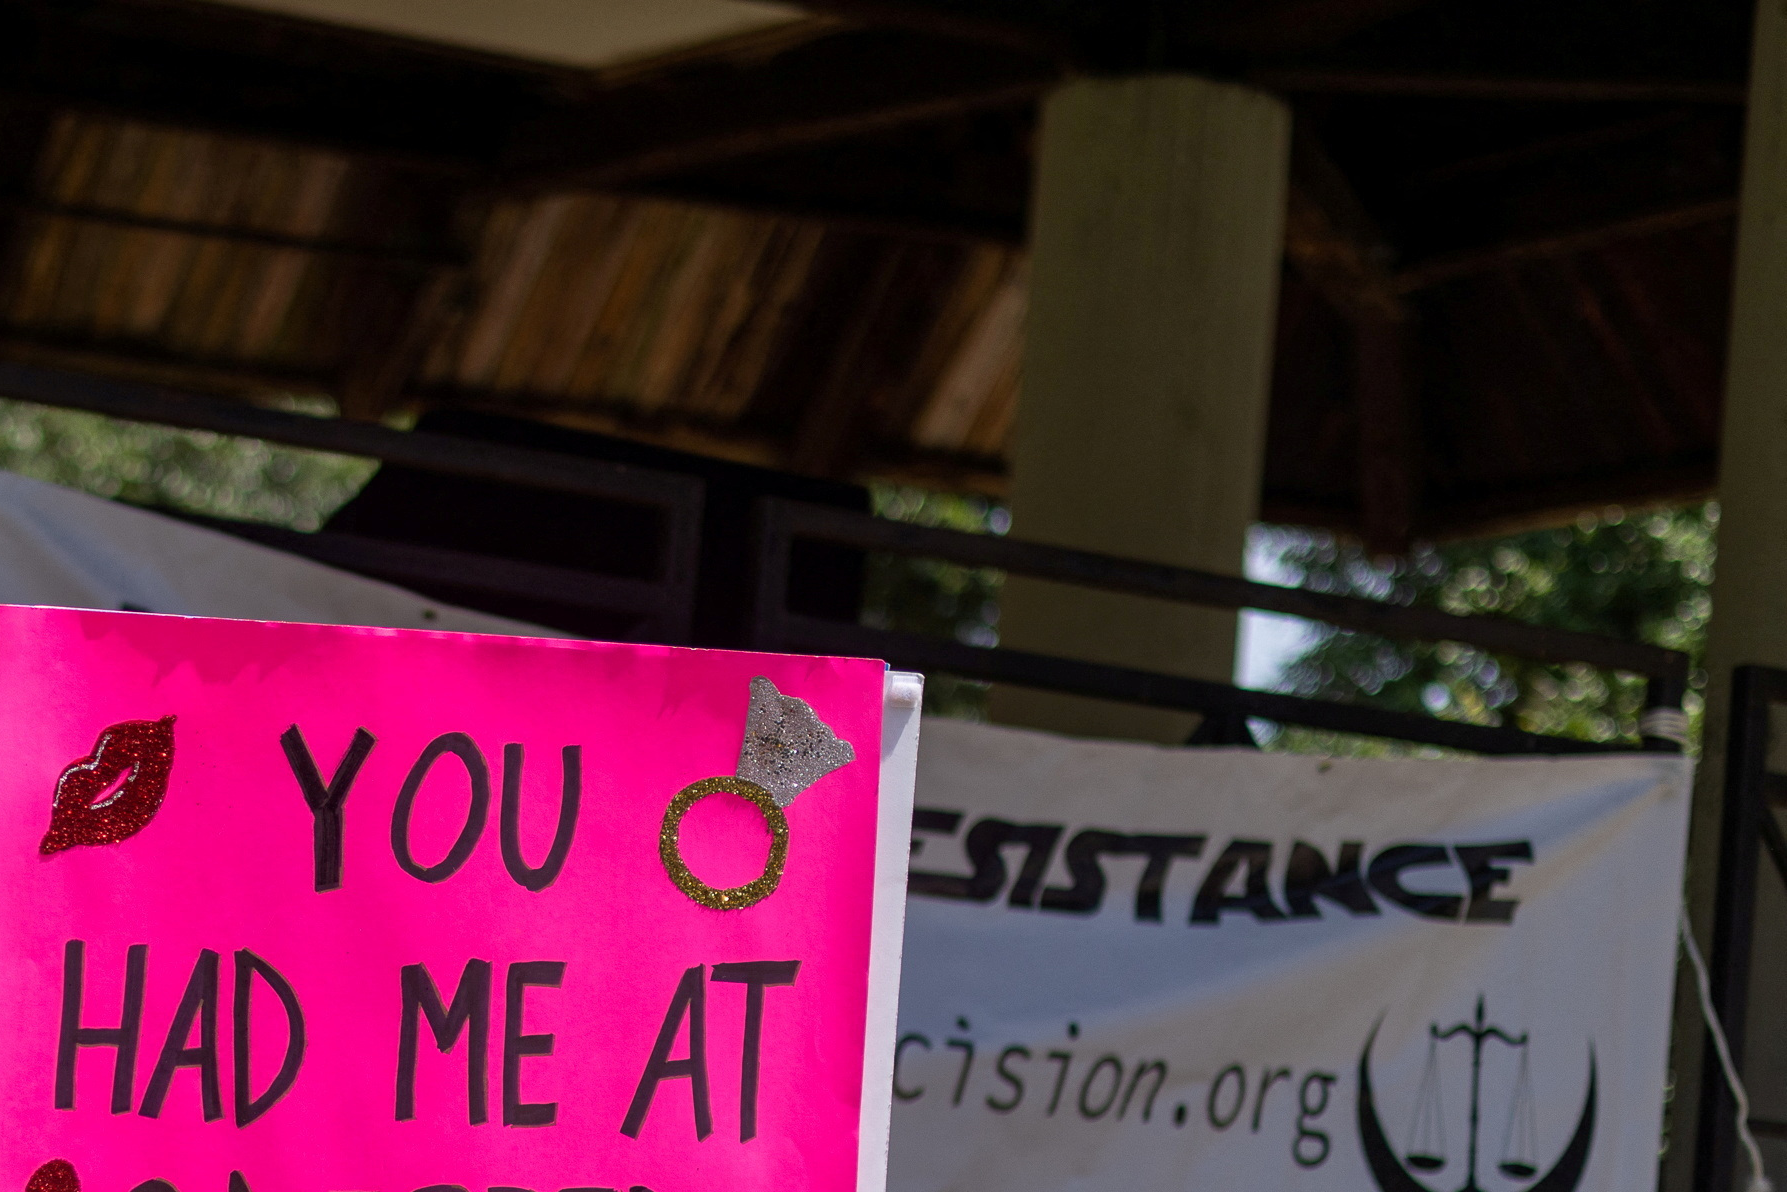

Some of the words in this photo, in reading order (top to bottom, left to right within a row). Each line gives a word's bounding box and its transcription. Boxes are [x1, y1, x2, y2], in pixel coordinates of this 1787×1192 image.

[280, 723, 583, 893] YOU
[907, 807, 1535, 929] ESISTANCE
[53, 937, 307, 1130] HAD
[393, 956, 568, 1128] ME
[619, 959, 802, 1144] AT
[892, 1016, 1340, 1169] cision.org
